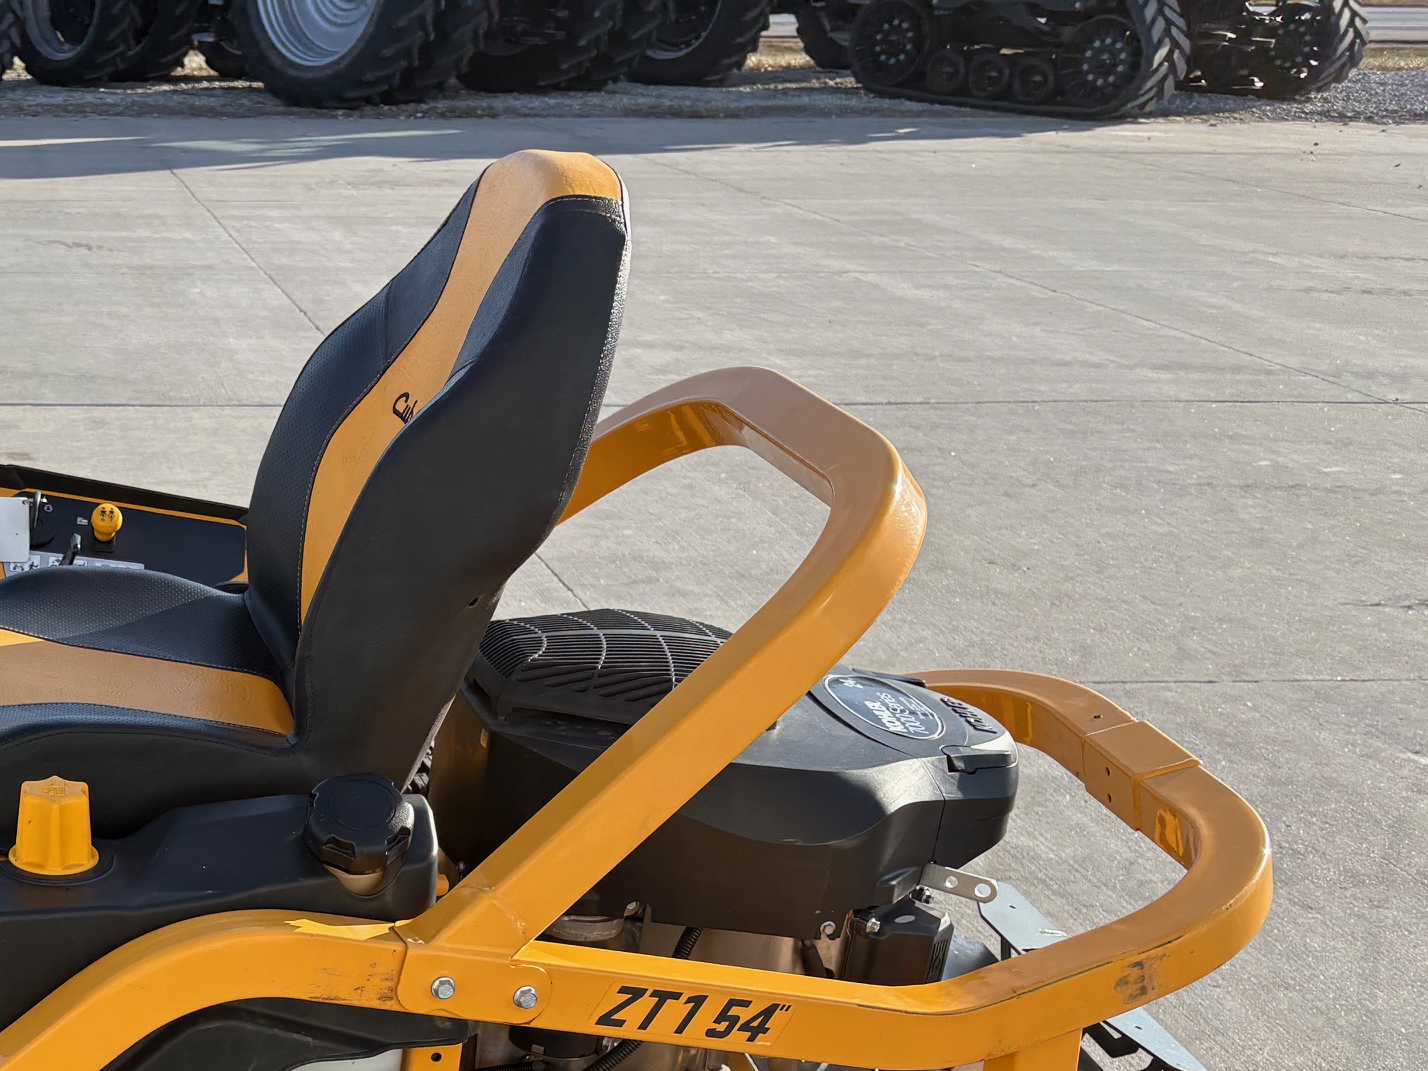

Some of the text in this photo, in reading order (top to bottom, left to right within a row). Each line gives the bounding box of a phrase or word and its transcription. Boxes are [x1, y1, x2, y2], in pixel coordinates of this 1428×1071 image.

[863, 700, 907, 731] KOHLER
[594, 985, 793, 1043] ZT1 54"
